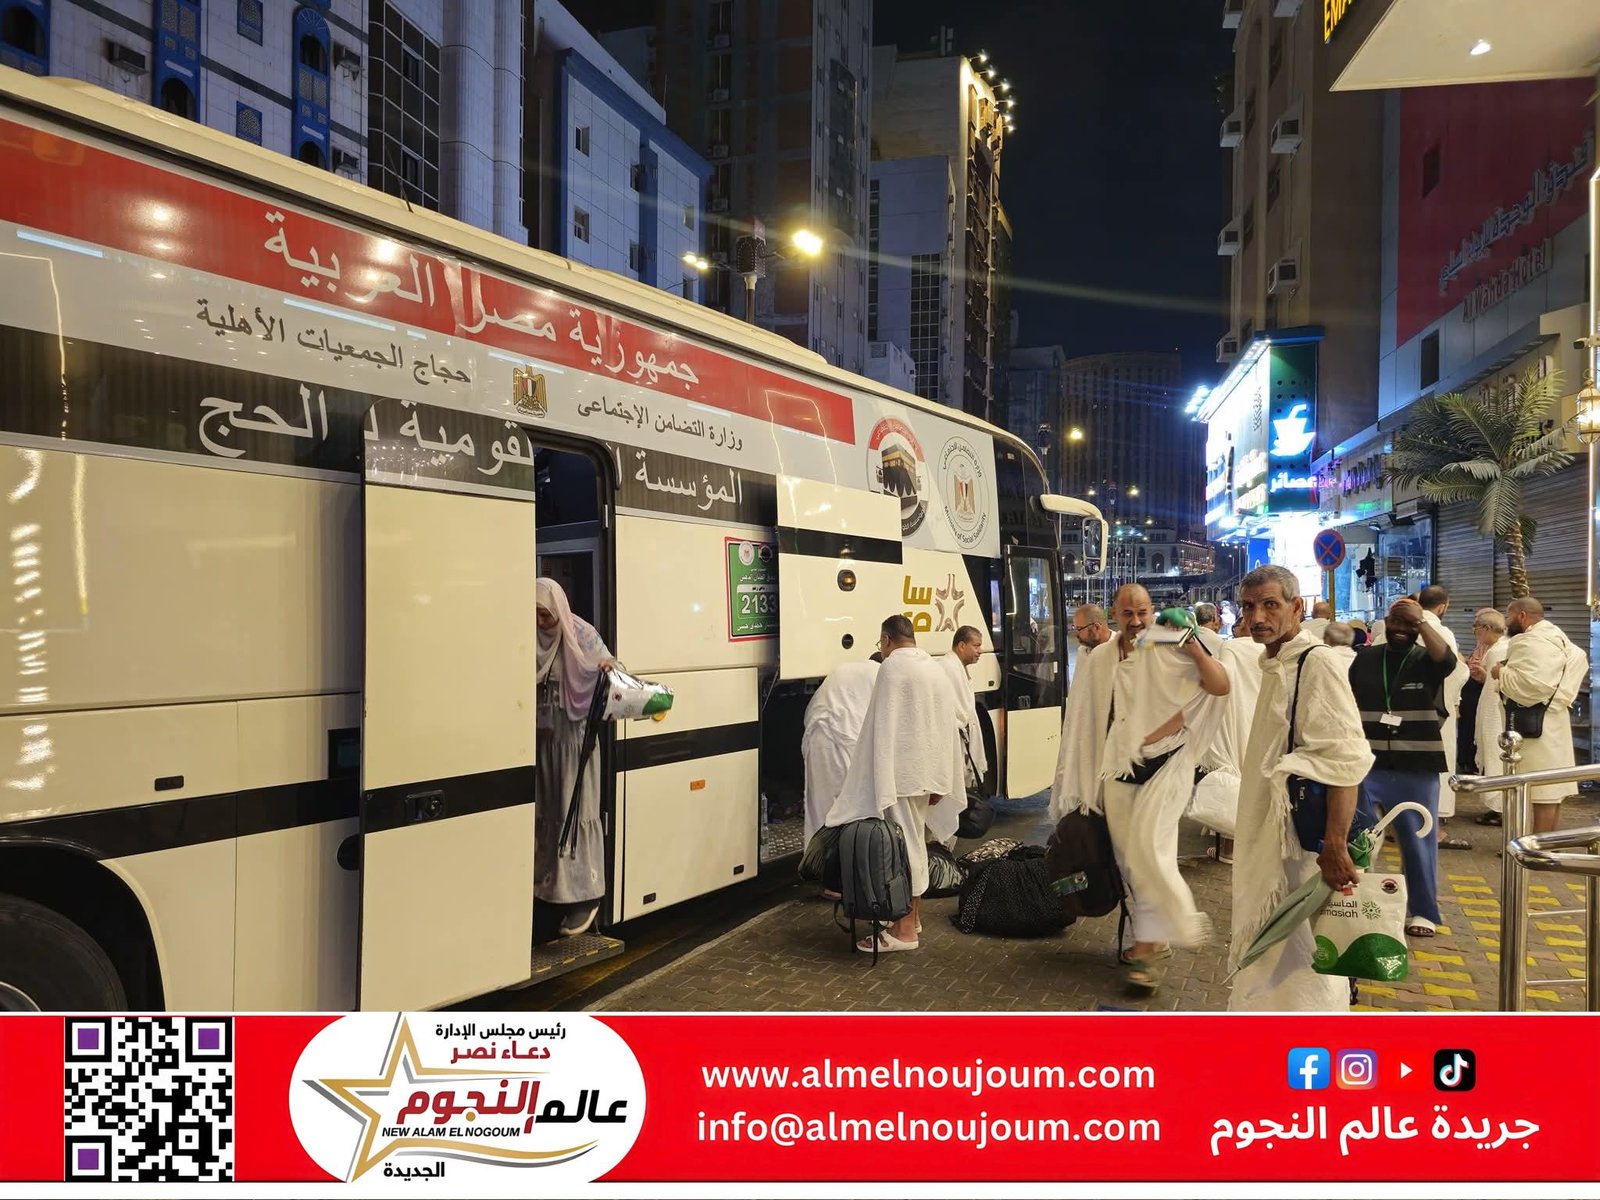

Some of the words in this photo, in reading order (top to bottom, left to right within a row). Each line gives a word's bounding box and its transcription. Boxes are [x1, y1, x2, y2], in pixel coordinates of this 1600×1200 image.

[264, 211, 435, 307] العربية
[1512, 239, 1551, 290] Hotel
[196, 298, 285, 343] الأهلية
[458, 303, 557, 342] مصر
[297, 328, 403, 369] الجمعيات
[569, 307, 699, 390] جمهورية
[412, 354, 471, 385] حجاج
[198, 383, 328, 458] الحج
[654, 414, 705, 438] التضامن
[708, 426, 743, 451] وزارة
[635, 450, 743, 511] المؤسسة
[1270, 471, 1318, 493] عصائر
[741, 593, 777, 614] 2133
